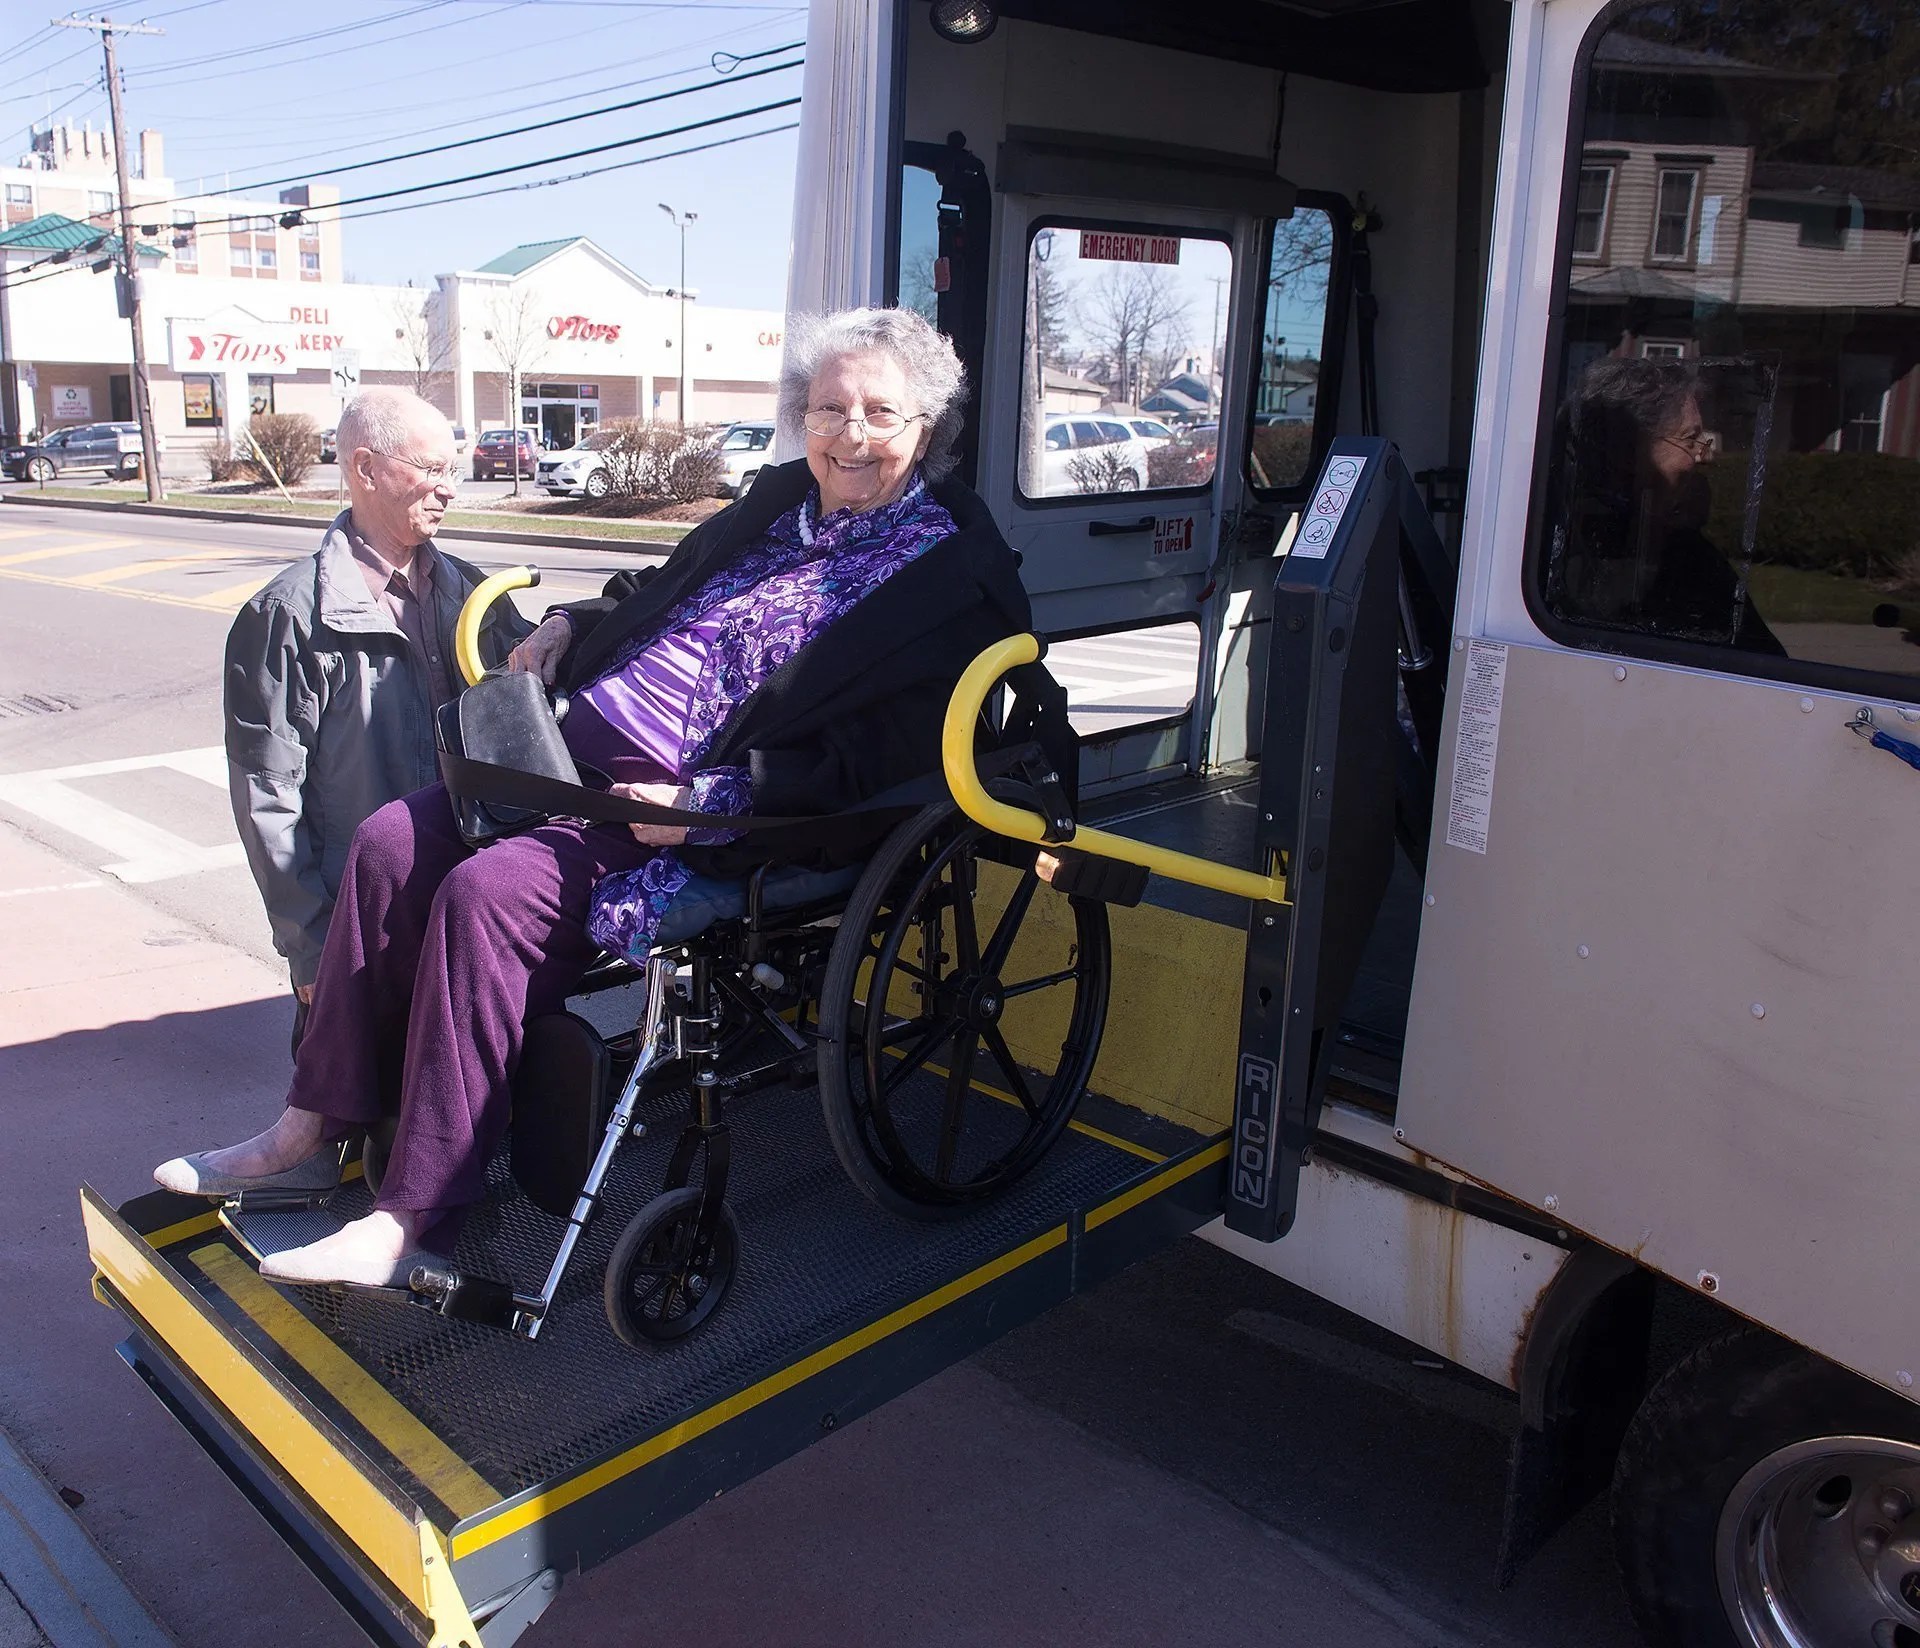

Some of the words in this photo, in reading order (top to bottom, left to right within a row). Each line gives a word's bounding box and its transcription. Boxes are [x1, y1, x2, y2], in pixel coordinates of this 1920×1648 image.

[1082, 234, 1146, 261] EMERGENCY
[1151, 239, 1177, 263] DOOR
[290, 307, 328, 324] DELI
[295, 334, 344, 351] KERY
[758, 332, 781, 346] CAF
[1155, 518, 1183, 537] LIFT
[1154, 539, 1163, 554] TO
[1165, 537, 1184, 553] OPEN
[1238, 1063, 1270, 1199] RICON
